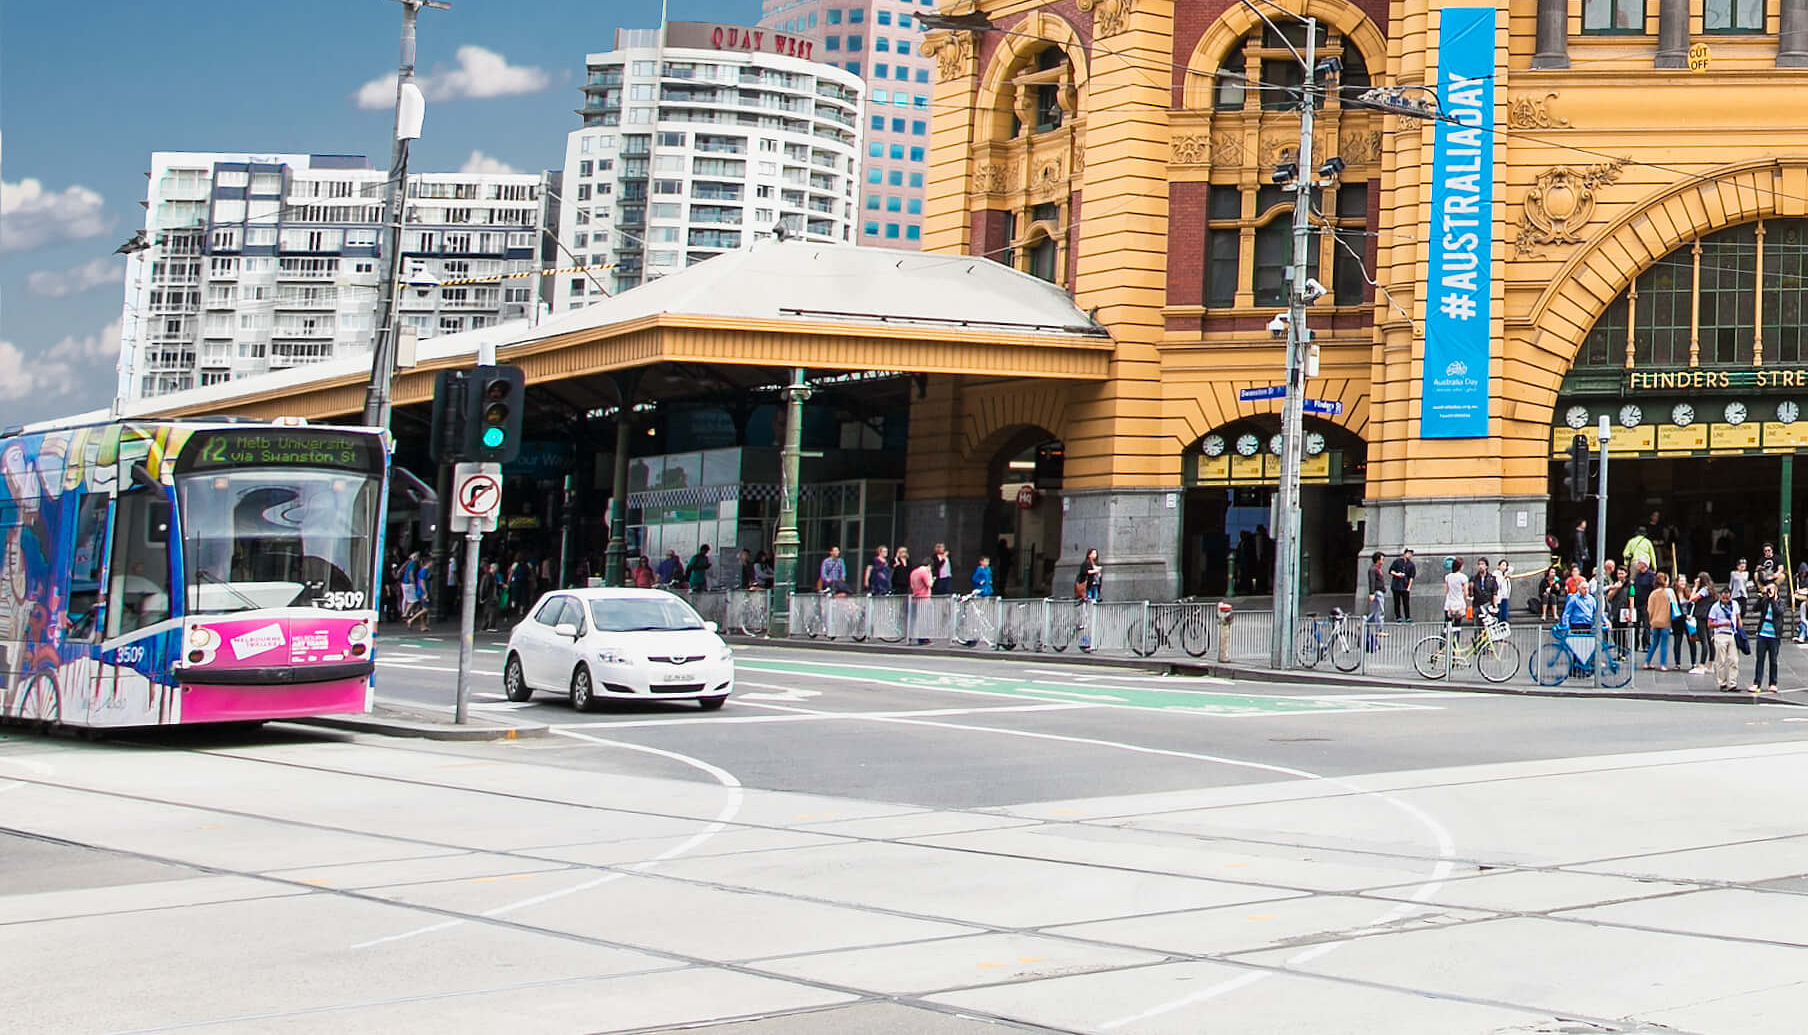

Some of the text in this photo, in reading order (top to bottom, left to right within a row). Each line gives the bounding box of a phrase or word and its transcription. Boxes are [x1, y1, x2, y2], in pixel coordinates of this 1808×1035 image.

[712, 27, 813, 60] QUAY WEST
[1689, 47, 1708, 59] CUT
[1690, 59, 1709, 71] OFF
[1440, 72, 1485, 321] #AUSTRALIADAY
[1433, 378, 1478, 388] Australia Day
[1629, 370, 1731, 389] FLINDERS
[237, 436, 271, 449] Melb
[279, 436, 354, 451] University
[230, 451, 357, 462] via Swanston St
[324, 591, 365, 608] 3509
[116, 646, 145, 663] 3509
